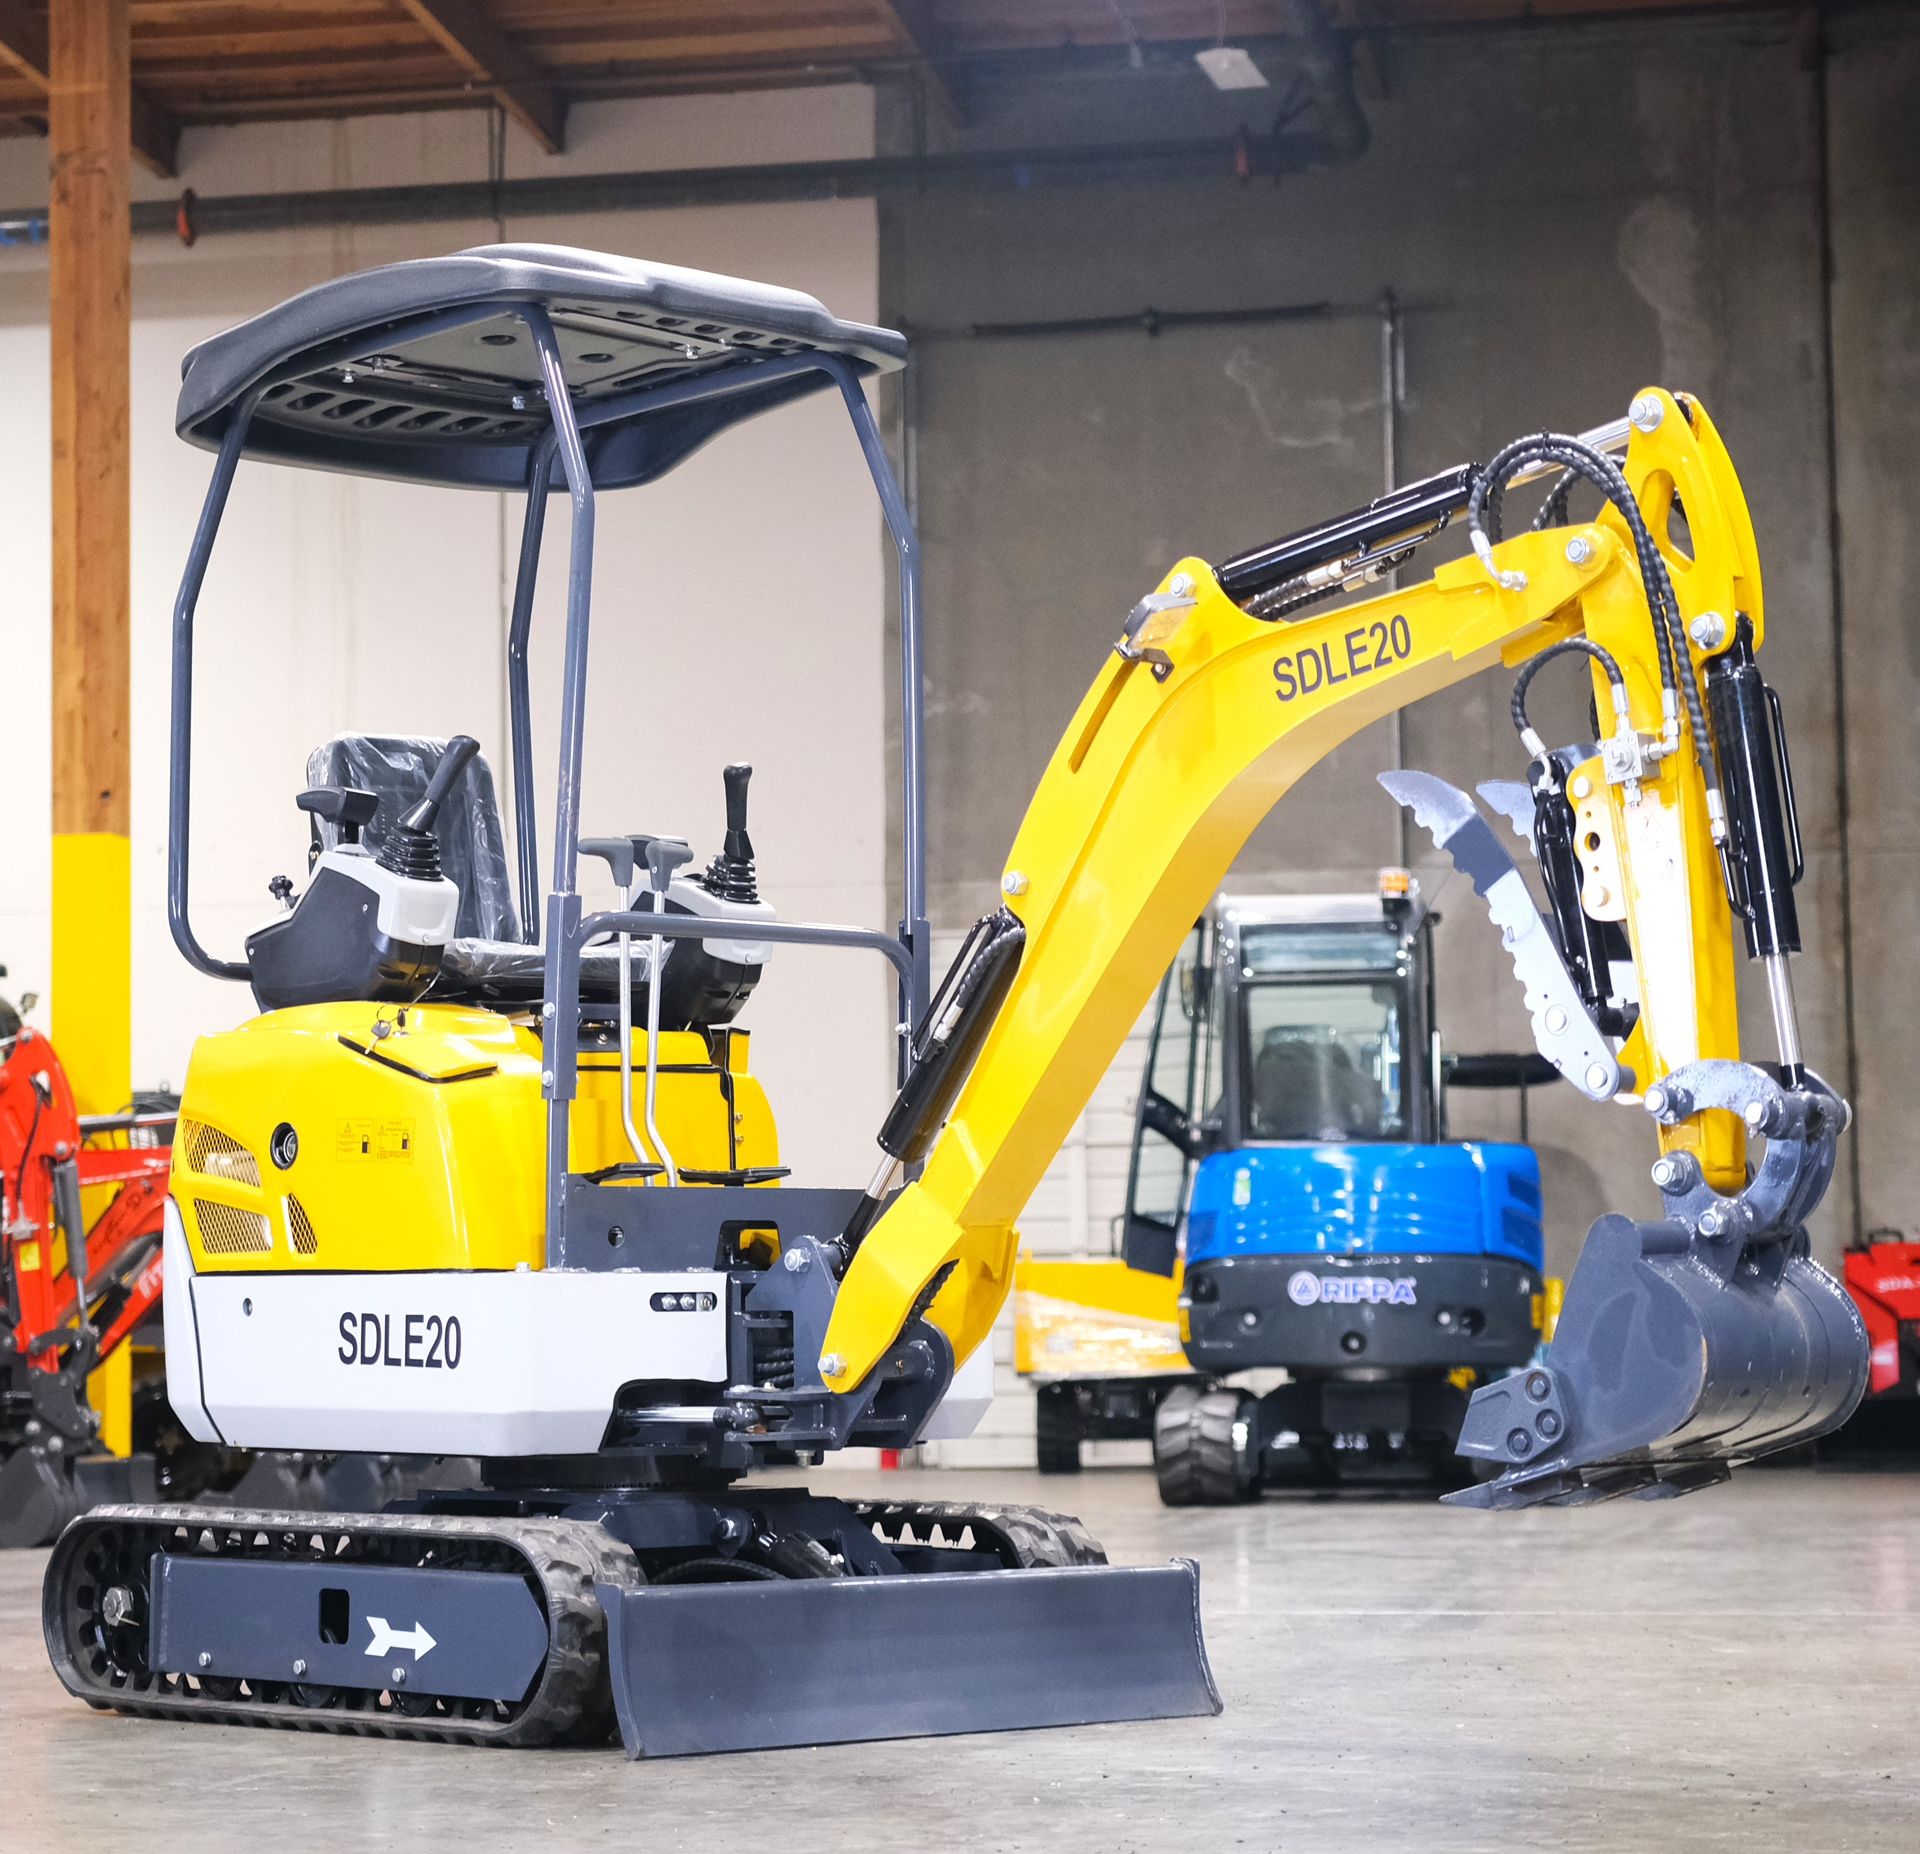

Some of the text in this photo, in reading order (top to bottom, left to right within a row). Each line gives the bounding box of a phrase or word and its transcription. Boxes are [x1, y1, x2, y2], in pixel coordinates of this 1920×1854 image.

[1273, 615, 1411, 702] SDLE20
[1320, 1277, 1416, 1304] RIPPA
[338, 1311, 461, 1369] SDLE20
